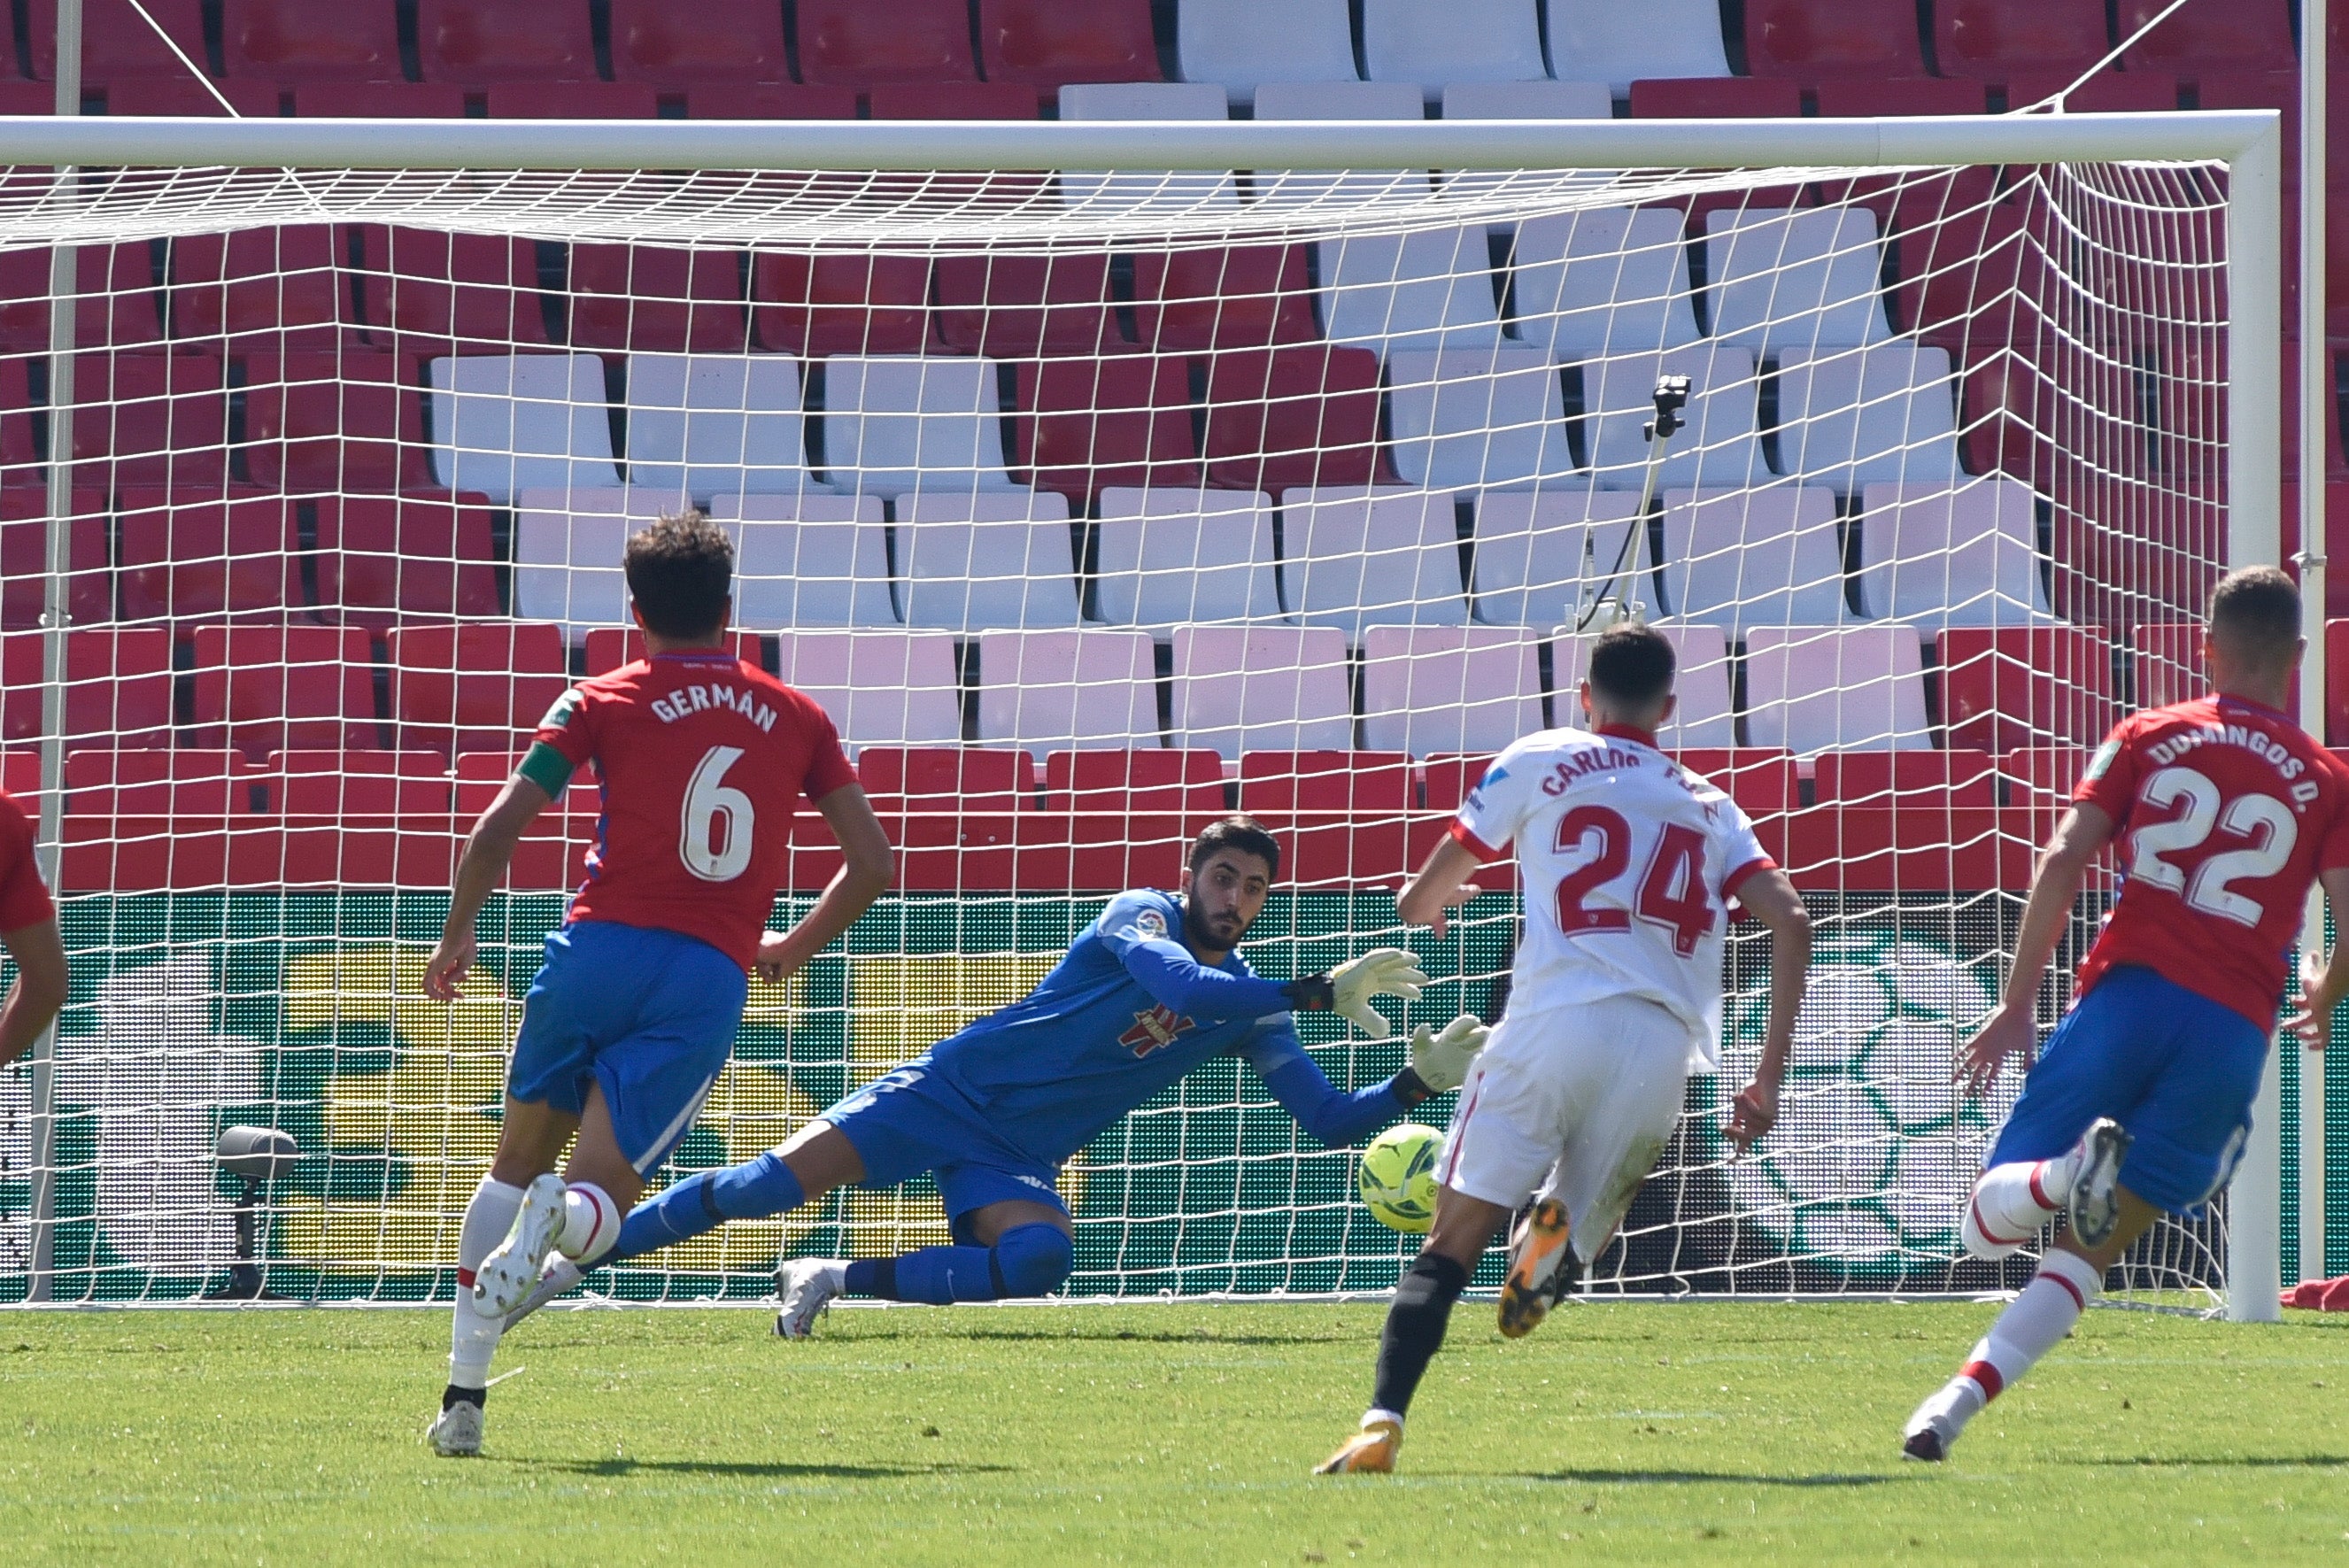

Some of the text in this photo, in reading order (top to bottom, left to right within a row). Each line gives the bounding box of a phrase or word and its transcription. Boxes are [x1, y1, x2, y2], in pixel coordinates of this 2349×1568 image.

[651, 683, 777, 734] GERMÁN
[679, 744, 755, 882] 6
[1552, 804, 1717, 960] 24
[2129, 765, 2299, 930] 22
